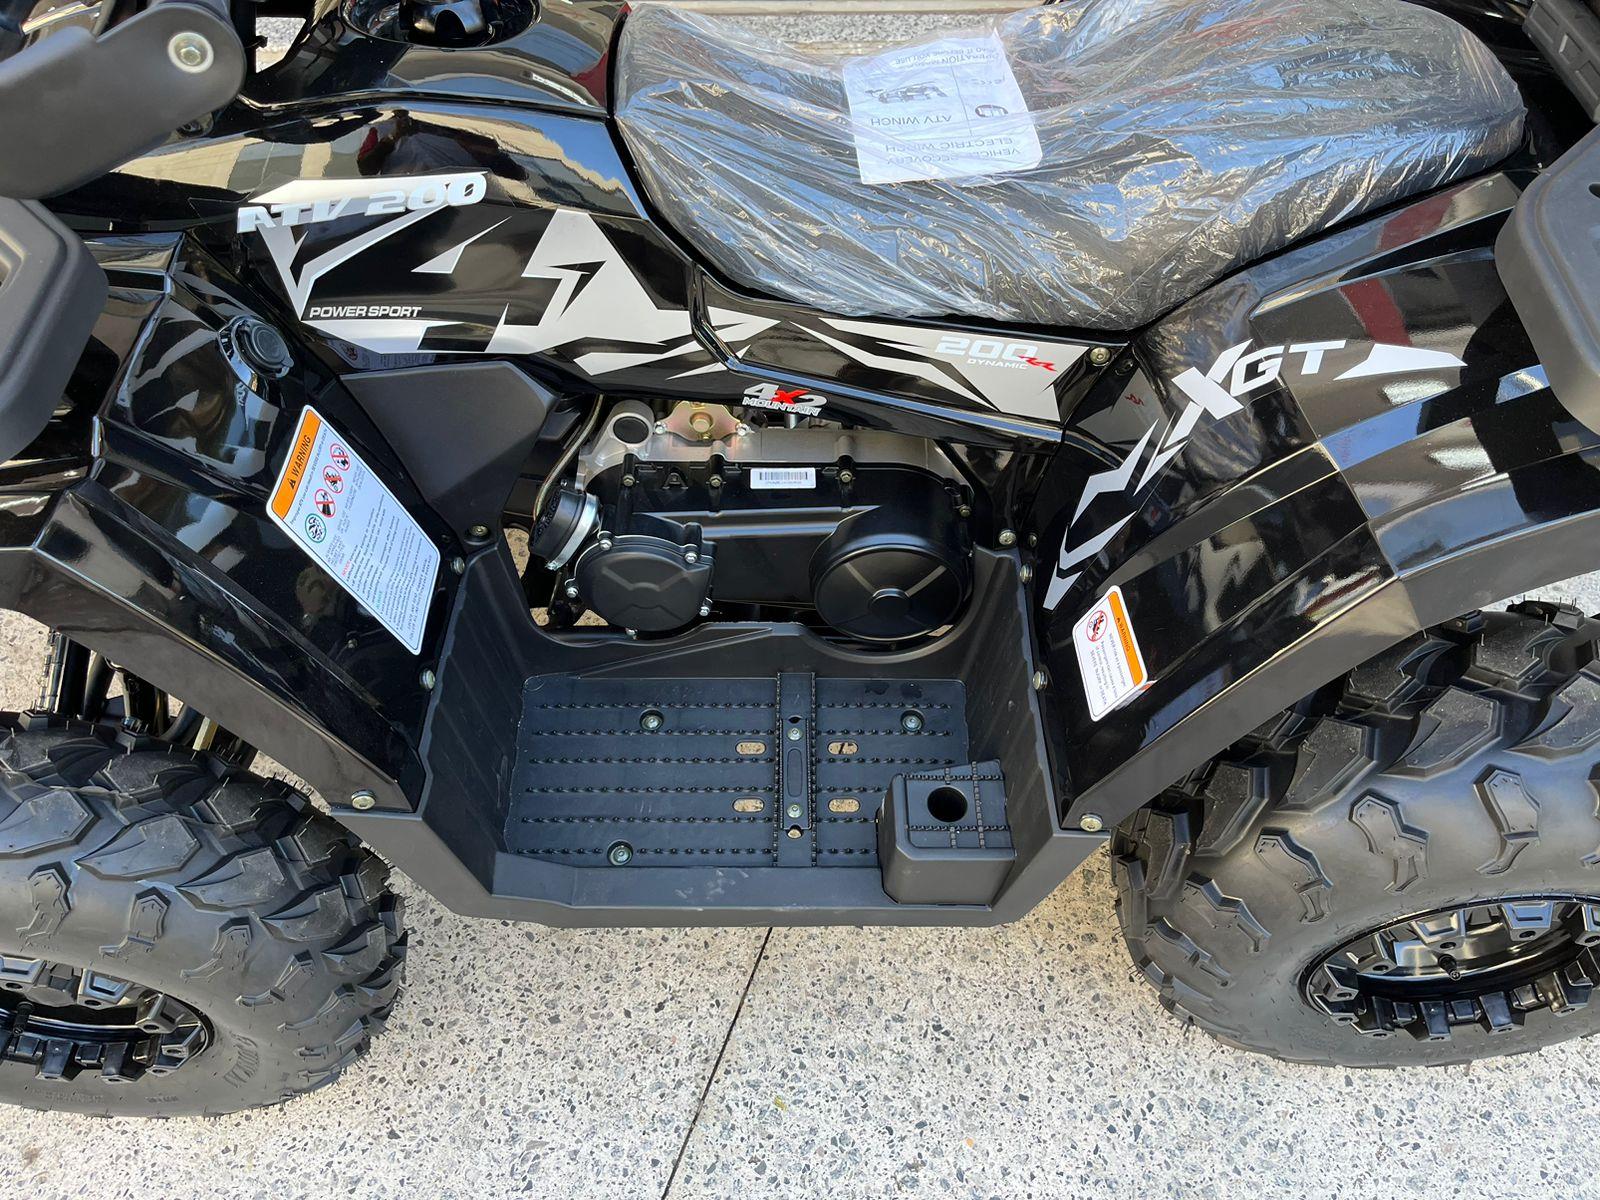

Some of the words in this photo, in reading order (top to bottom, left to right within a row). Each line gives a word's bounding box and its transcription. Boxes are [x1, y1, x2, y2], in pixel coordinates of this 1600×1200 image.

[871, 117, 920, 126] WINCH
[924, 115, 952, 124] ATV
[885, 142, 936, 153] WINCH
[940, 138, 1013, 151] ELECTRIC
[970, 147, 1021, 157] VEHICL
[237, 199, 350, 234] ATV
[365, 173, 487, 217] 200
[935, 336, 1038, 361] 200
[967, 358, 1028, 370] DYNAMIC
[742, 396, 822, 416] MOUNTAIN
[291, 434, 311, 477] WARNING
